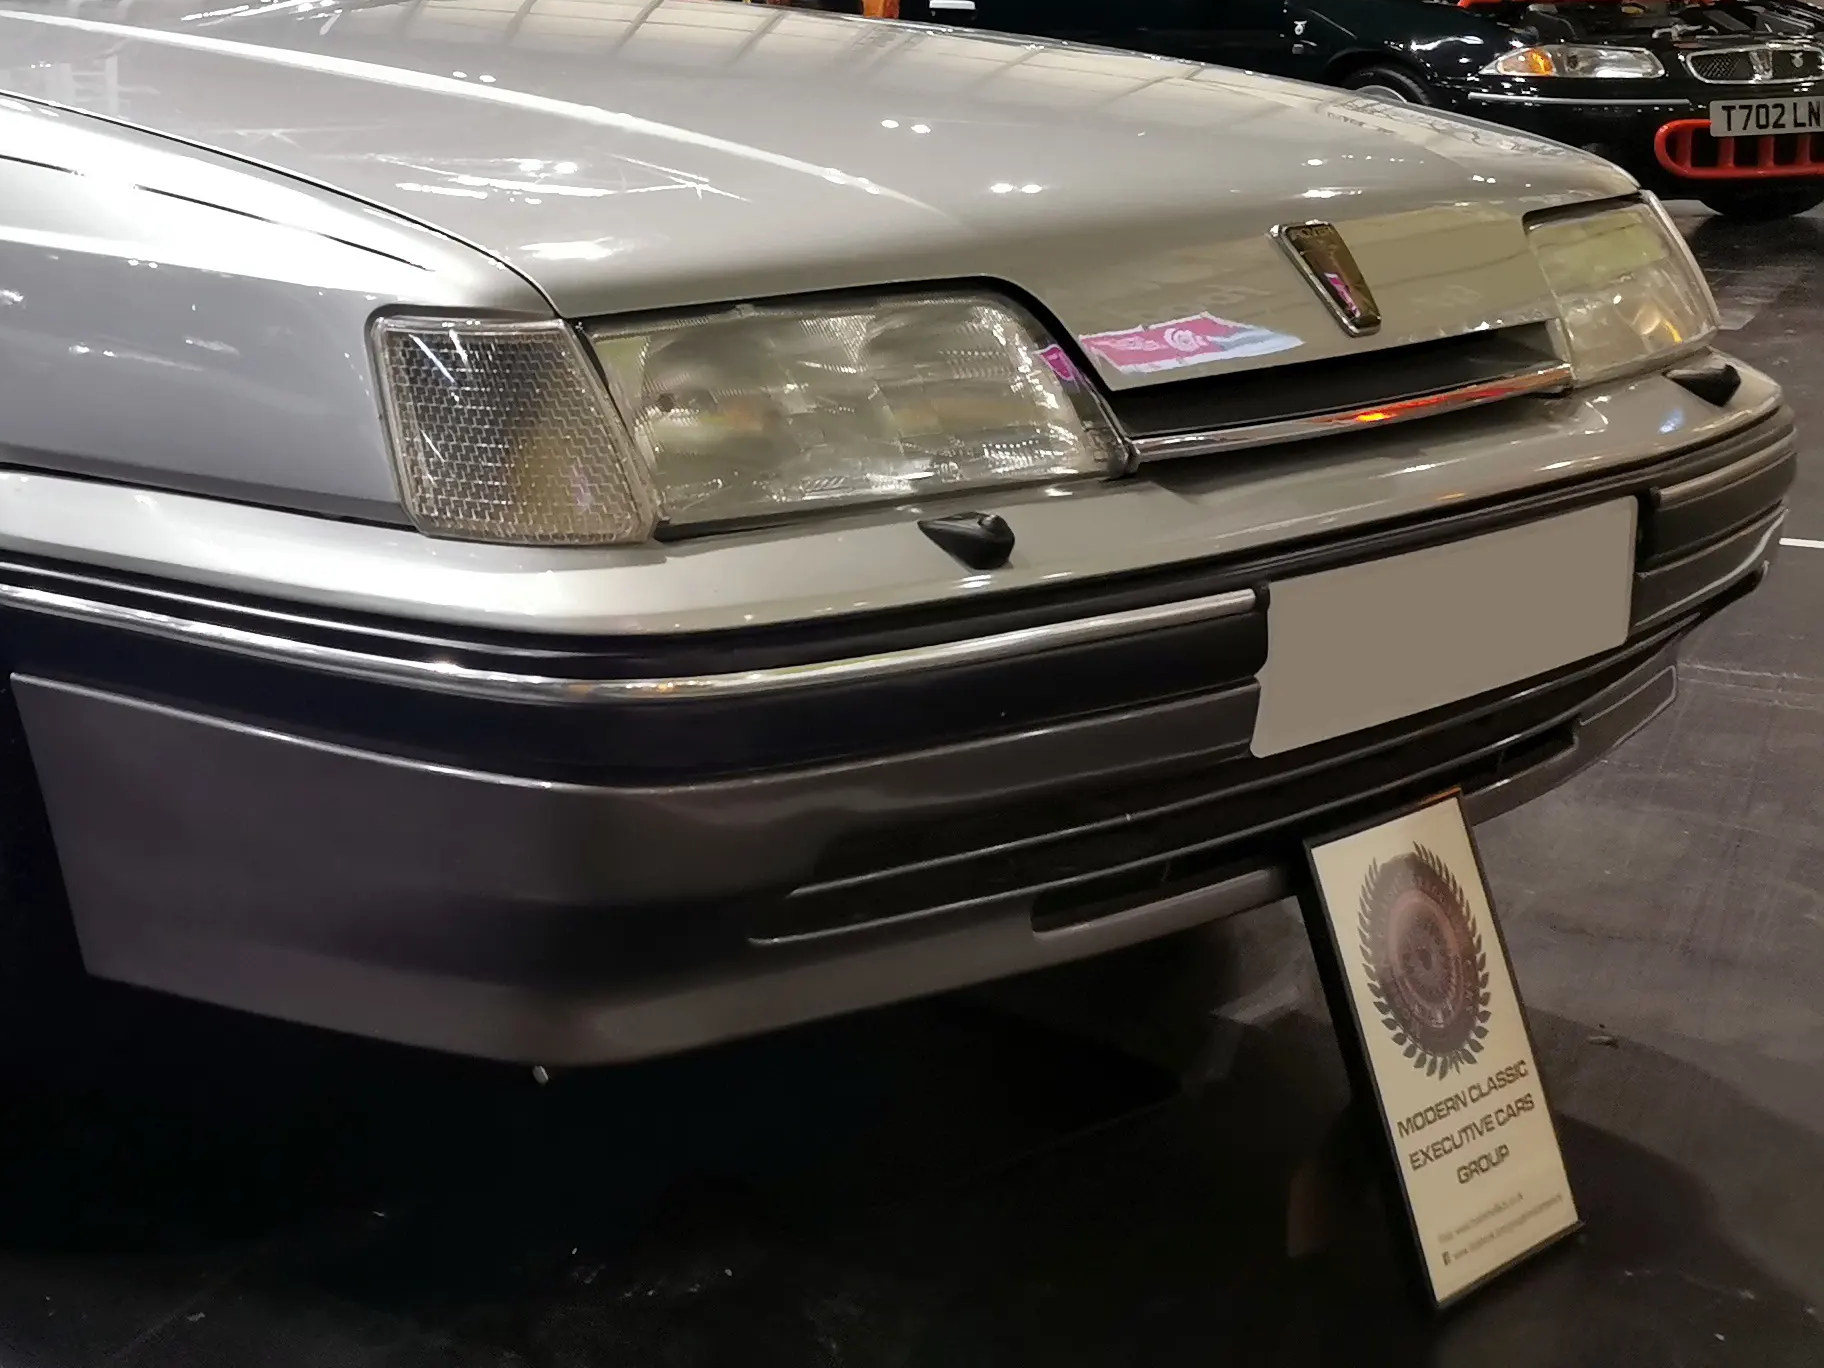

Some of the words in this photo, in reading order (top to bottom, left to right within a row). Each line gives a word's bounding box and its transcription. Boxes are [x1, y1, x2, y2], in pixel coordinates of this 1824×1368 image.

[1721, 103, 1785, 131] T702
[1396, 1090, 1469, 1139] MODERN
[1468, 1059, 1529, 1104] CLASSIC
[1408, 1113, 1496, 1172] EXECUTIVE
[1494, 1092, 1535, 1127] CARS
[1456, 1143, 1510, 1185] GROUP
